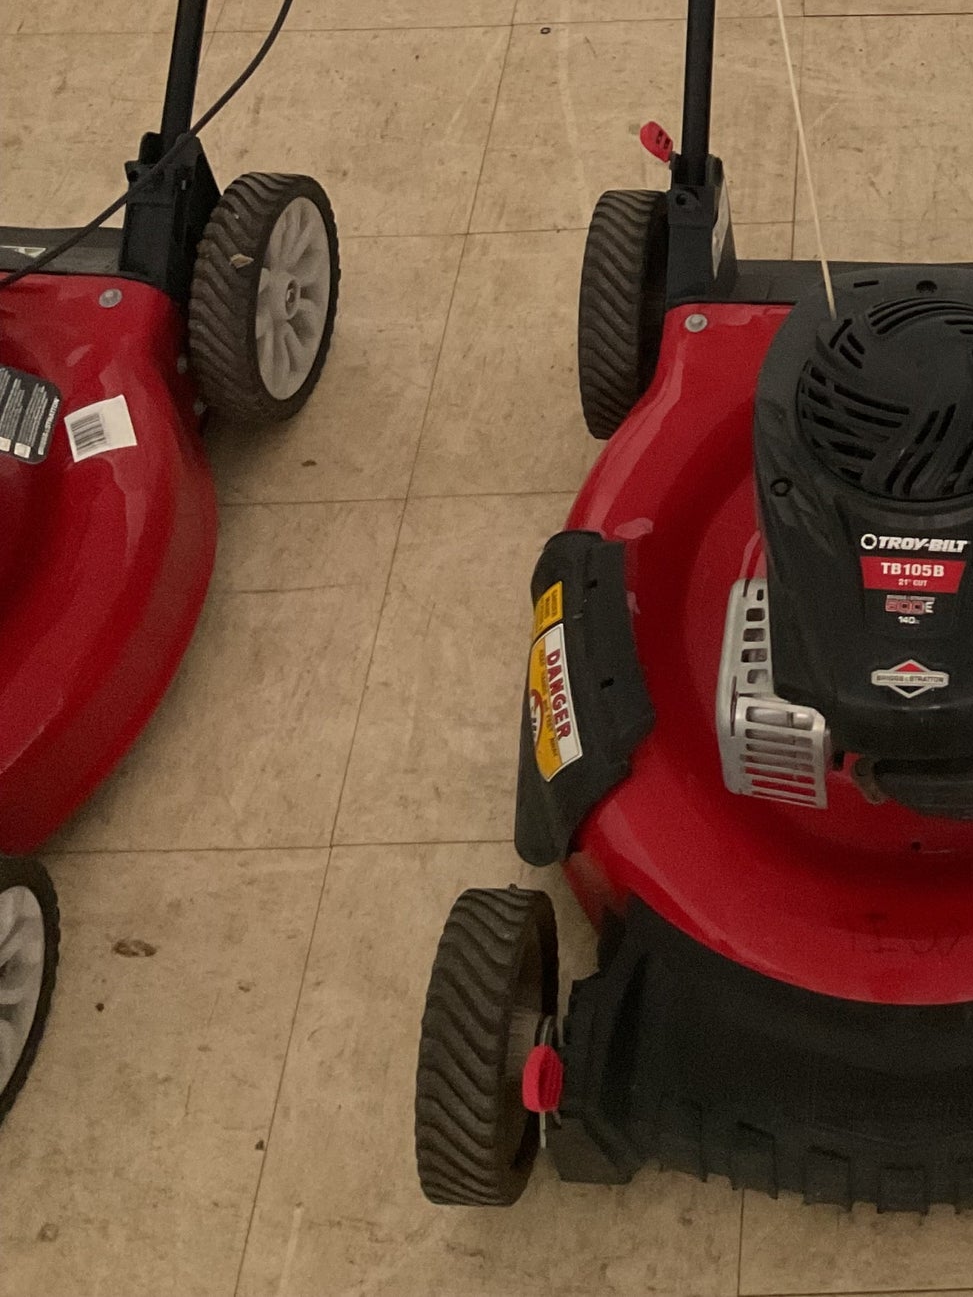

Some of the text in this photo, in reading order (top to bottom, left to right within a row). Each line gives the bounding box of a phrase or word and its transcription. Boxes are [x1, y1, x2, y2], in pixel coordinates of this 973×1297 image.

[878, 536, 968, 553] TROY-BILT
[880, 562, 945, 578] TB105B
[912, 579, 928, 587] CUT
[546, 648, 571, 742] DANGER
